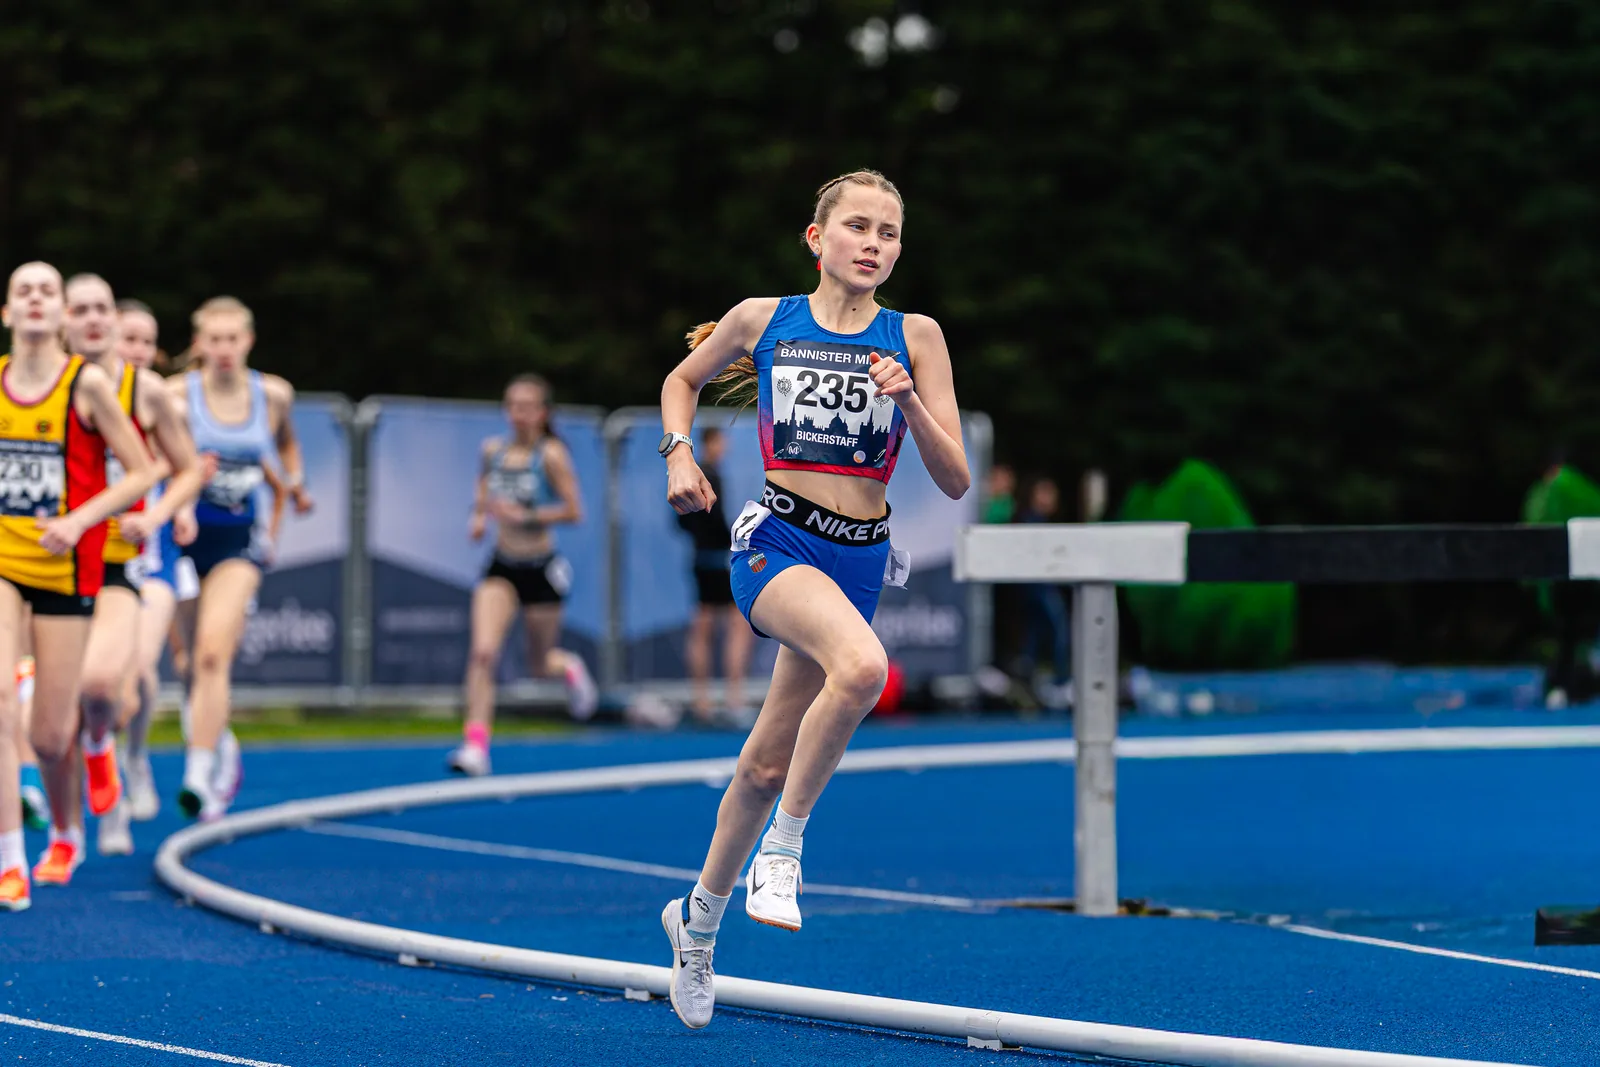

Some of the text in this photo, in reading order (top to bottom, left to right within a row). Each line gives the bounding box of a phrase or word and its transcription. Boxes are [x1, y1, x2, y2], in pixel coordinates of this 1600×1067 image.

[780, 348, 872, 365] BANNISTER MI
[795, 370, 869, 413] 235
[796, 430, 858, 447] BICKERSTAFF
[761, 485, 795, 514] RO
[805, 510, 872, 541] NIKE
